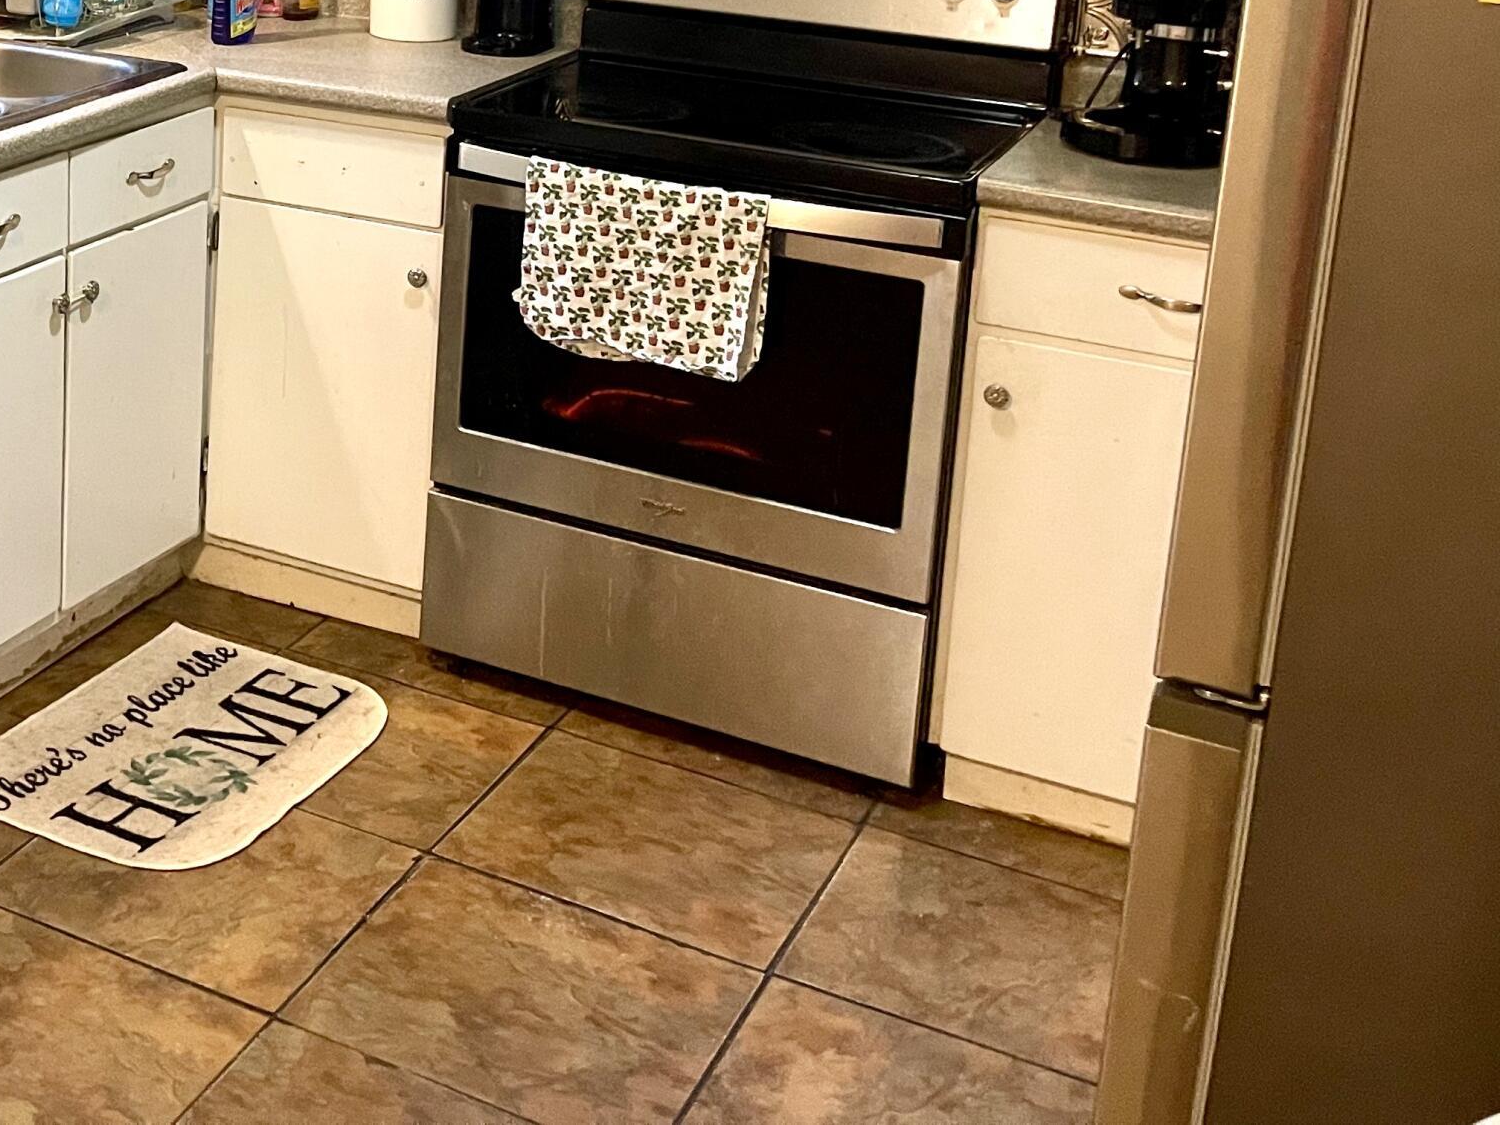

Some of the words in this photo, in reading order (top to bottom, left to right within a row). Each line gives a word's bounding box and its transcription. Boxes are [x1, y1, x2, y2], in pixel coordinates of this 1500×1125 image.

[84, 720, 126, 750] no
[126, 675, 196, 728] place
[185, 643, 239, 679] like
